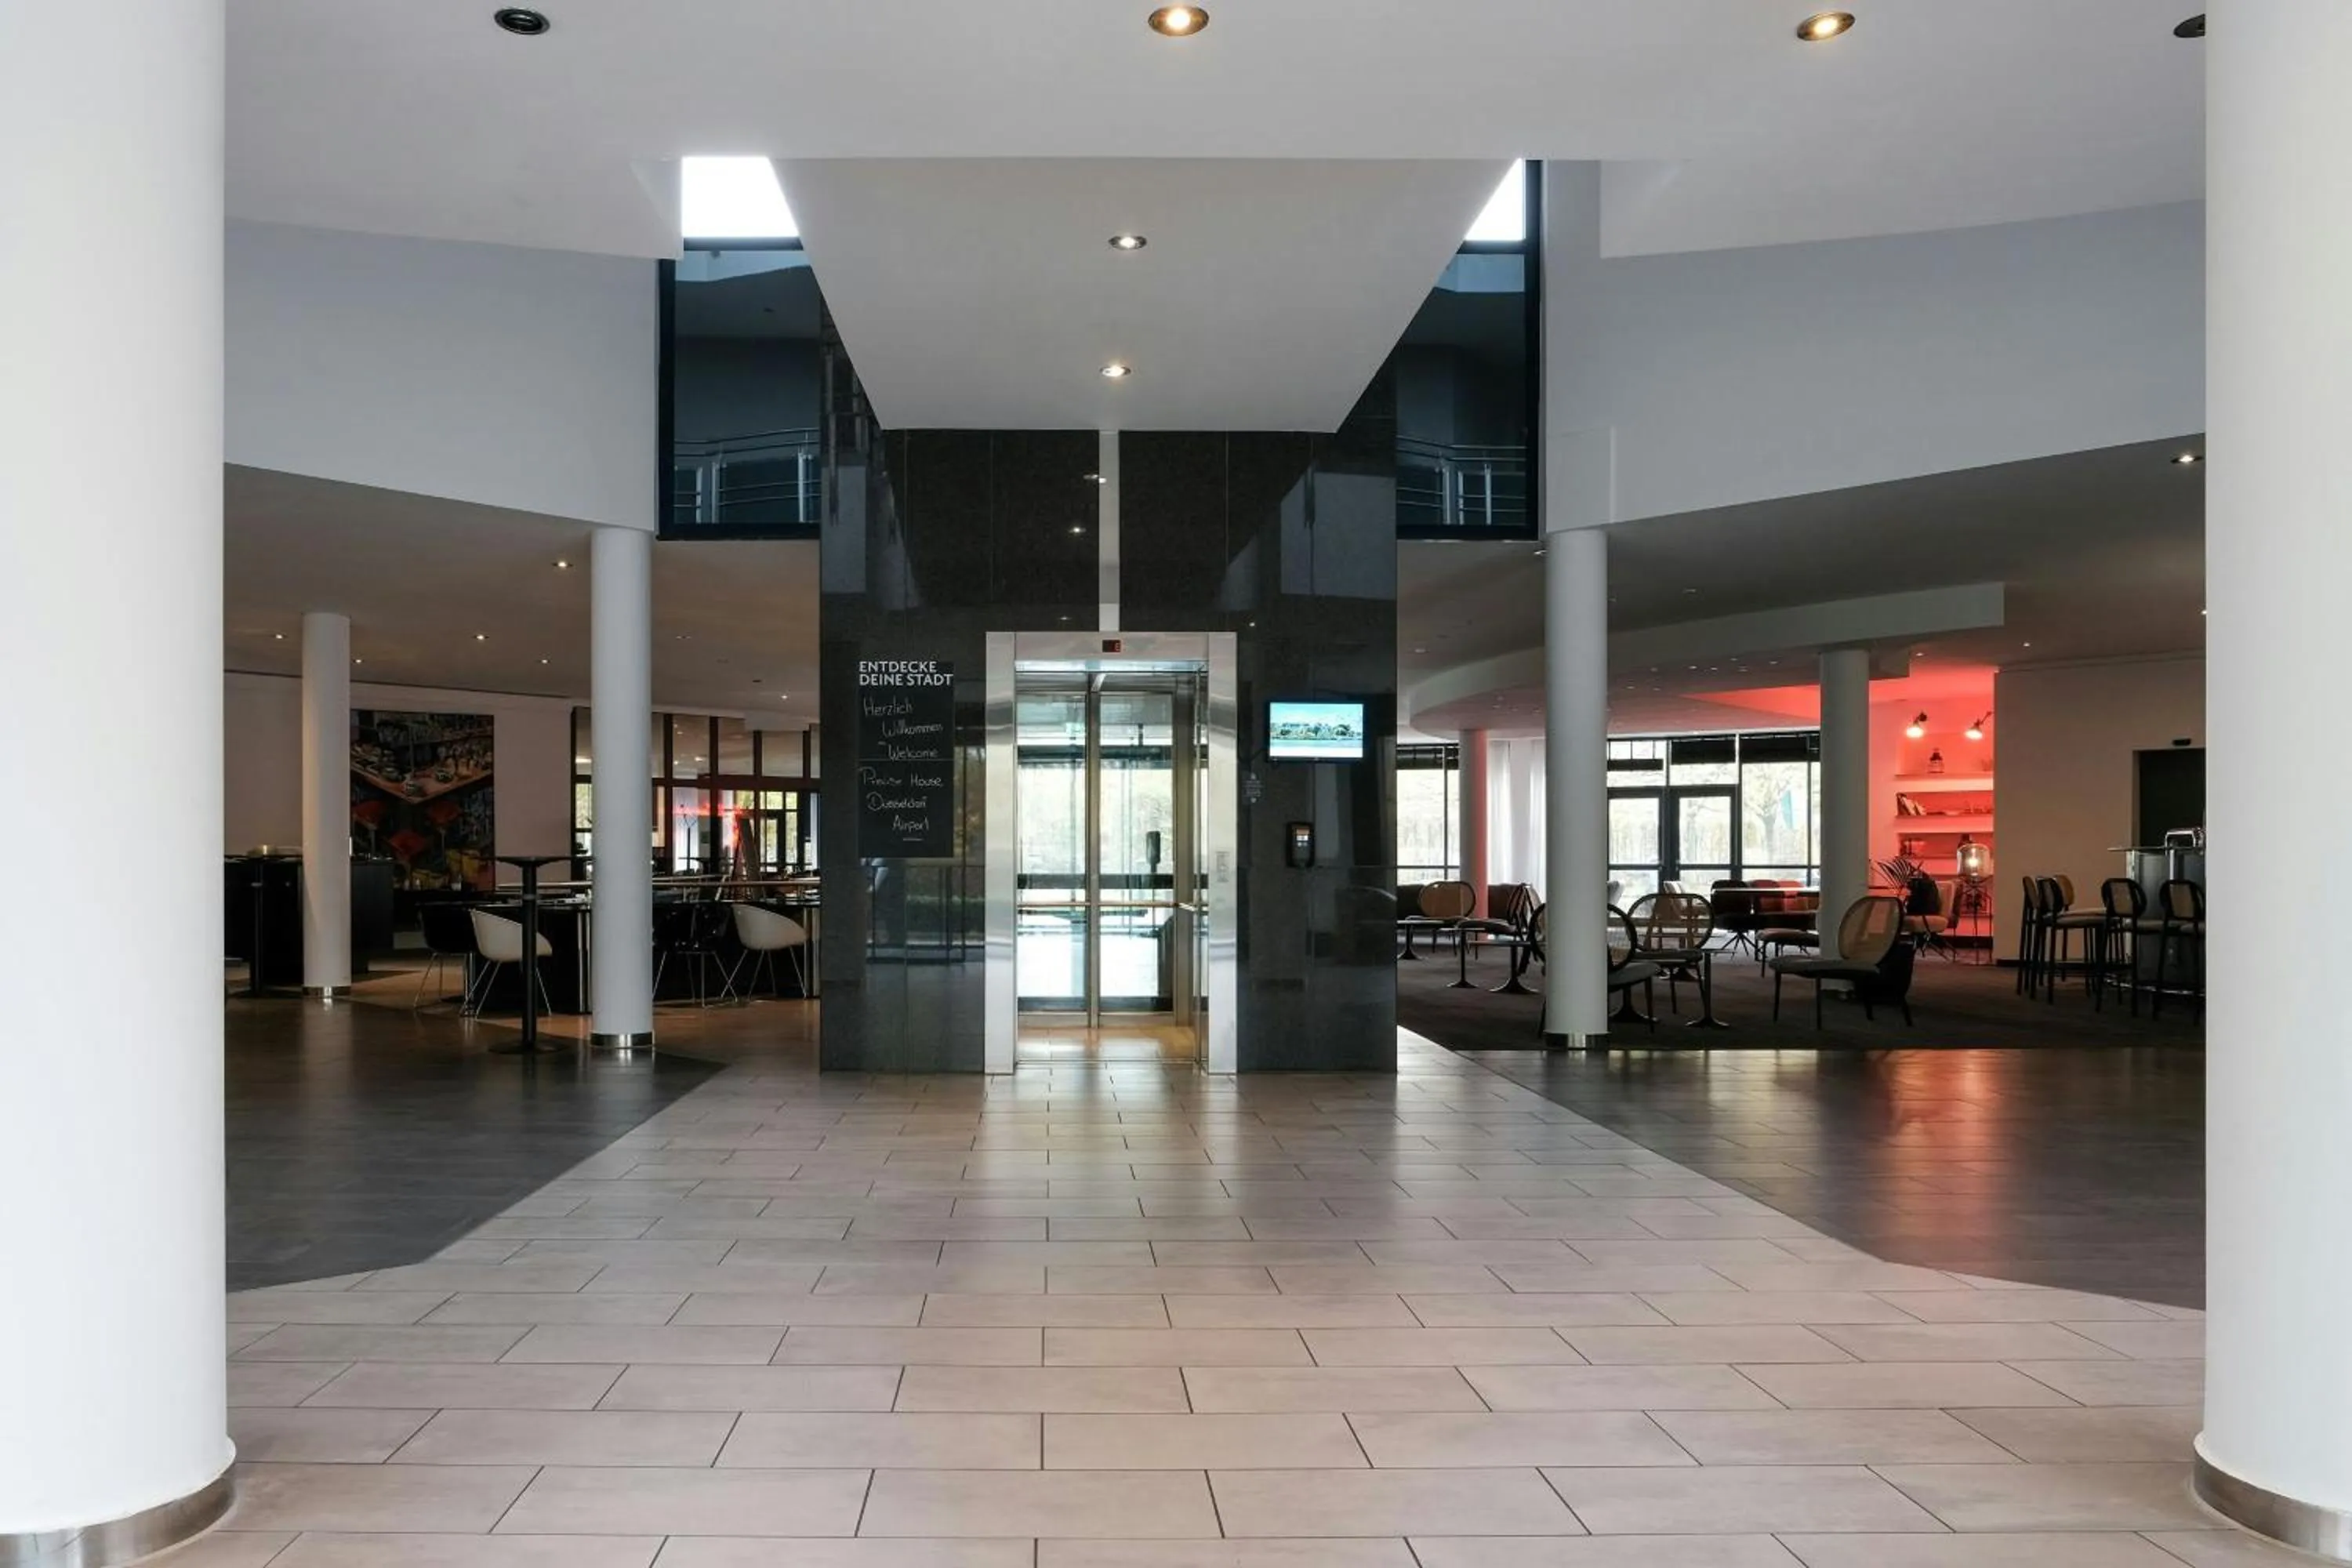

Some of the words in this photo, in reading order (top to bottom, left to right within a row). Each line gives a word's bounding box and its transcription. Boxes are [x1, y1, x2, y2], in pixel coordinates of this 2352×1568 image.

[858, 661, 938, 673] ENTDECKE
[858, 673, 903, 686] DEINE
[906, 673, 954, 686] STADT
[863, 695, 914, 717] Herzlich
[891, 815, 930, 833] Airport
